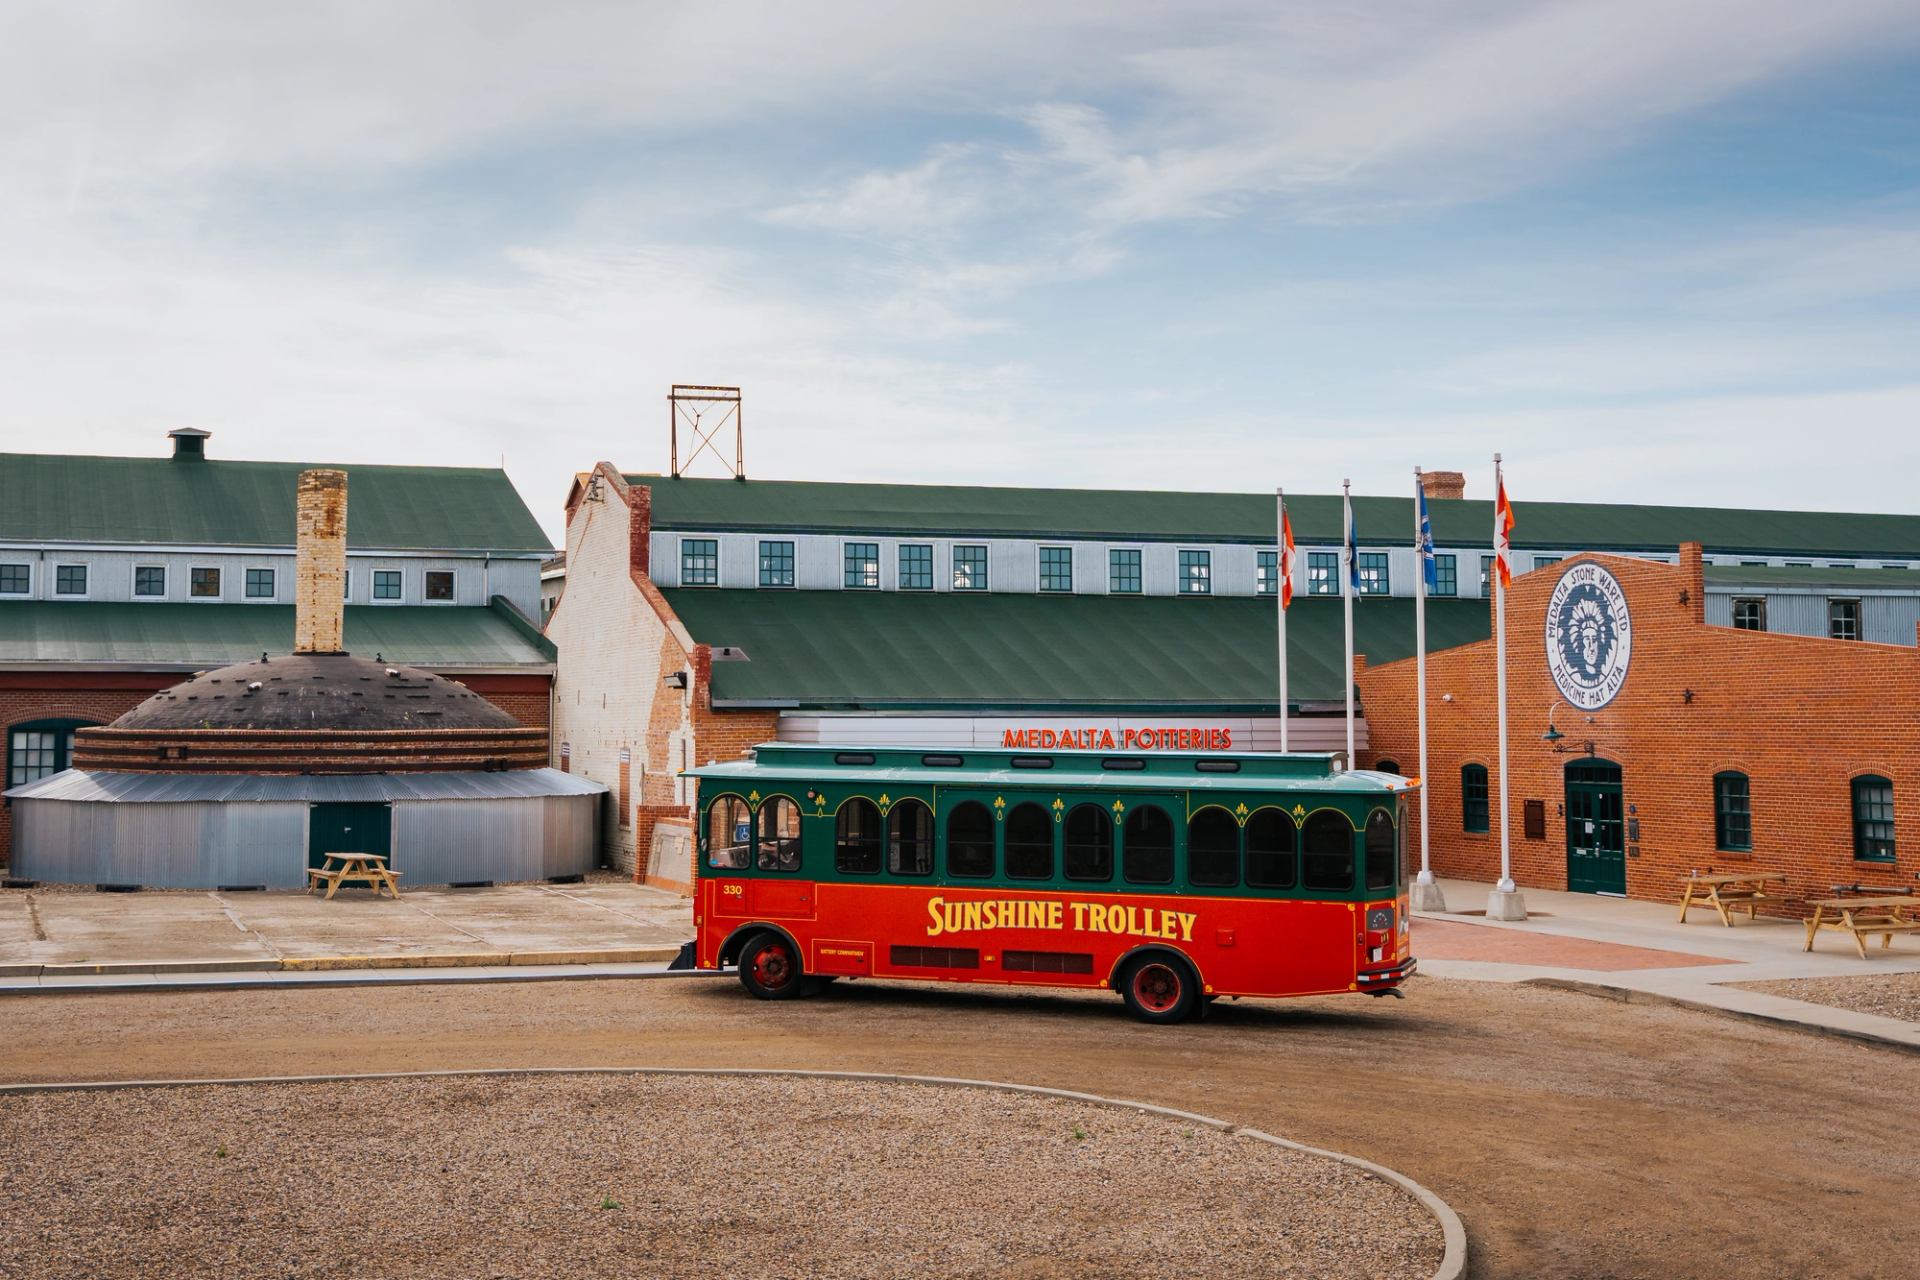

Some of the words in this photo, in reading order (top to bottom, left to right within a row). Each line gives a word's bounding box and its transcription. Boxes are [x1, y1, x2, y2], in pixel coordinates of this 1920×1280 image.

[1548, 582, 1569, 638] MEDALTA
[1571, 567, 1595, 585] STONE
[1599, 571, 1620, 606] WARE
[1553, 663, 1585, 705] MEDICINE
[1589, 688, 1606, 705] HAT
[1003, 728, 1115, 749] MEDALTA
[1124, 728, 1232, 749] POTTERIES
[723, 884, 743, 895] 330
[927, 896, 1064, 936] SUNSHINE
[1070, 902, 1197, 942] TROLLEY
